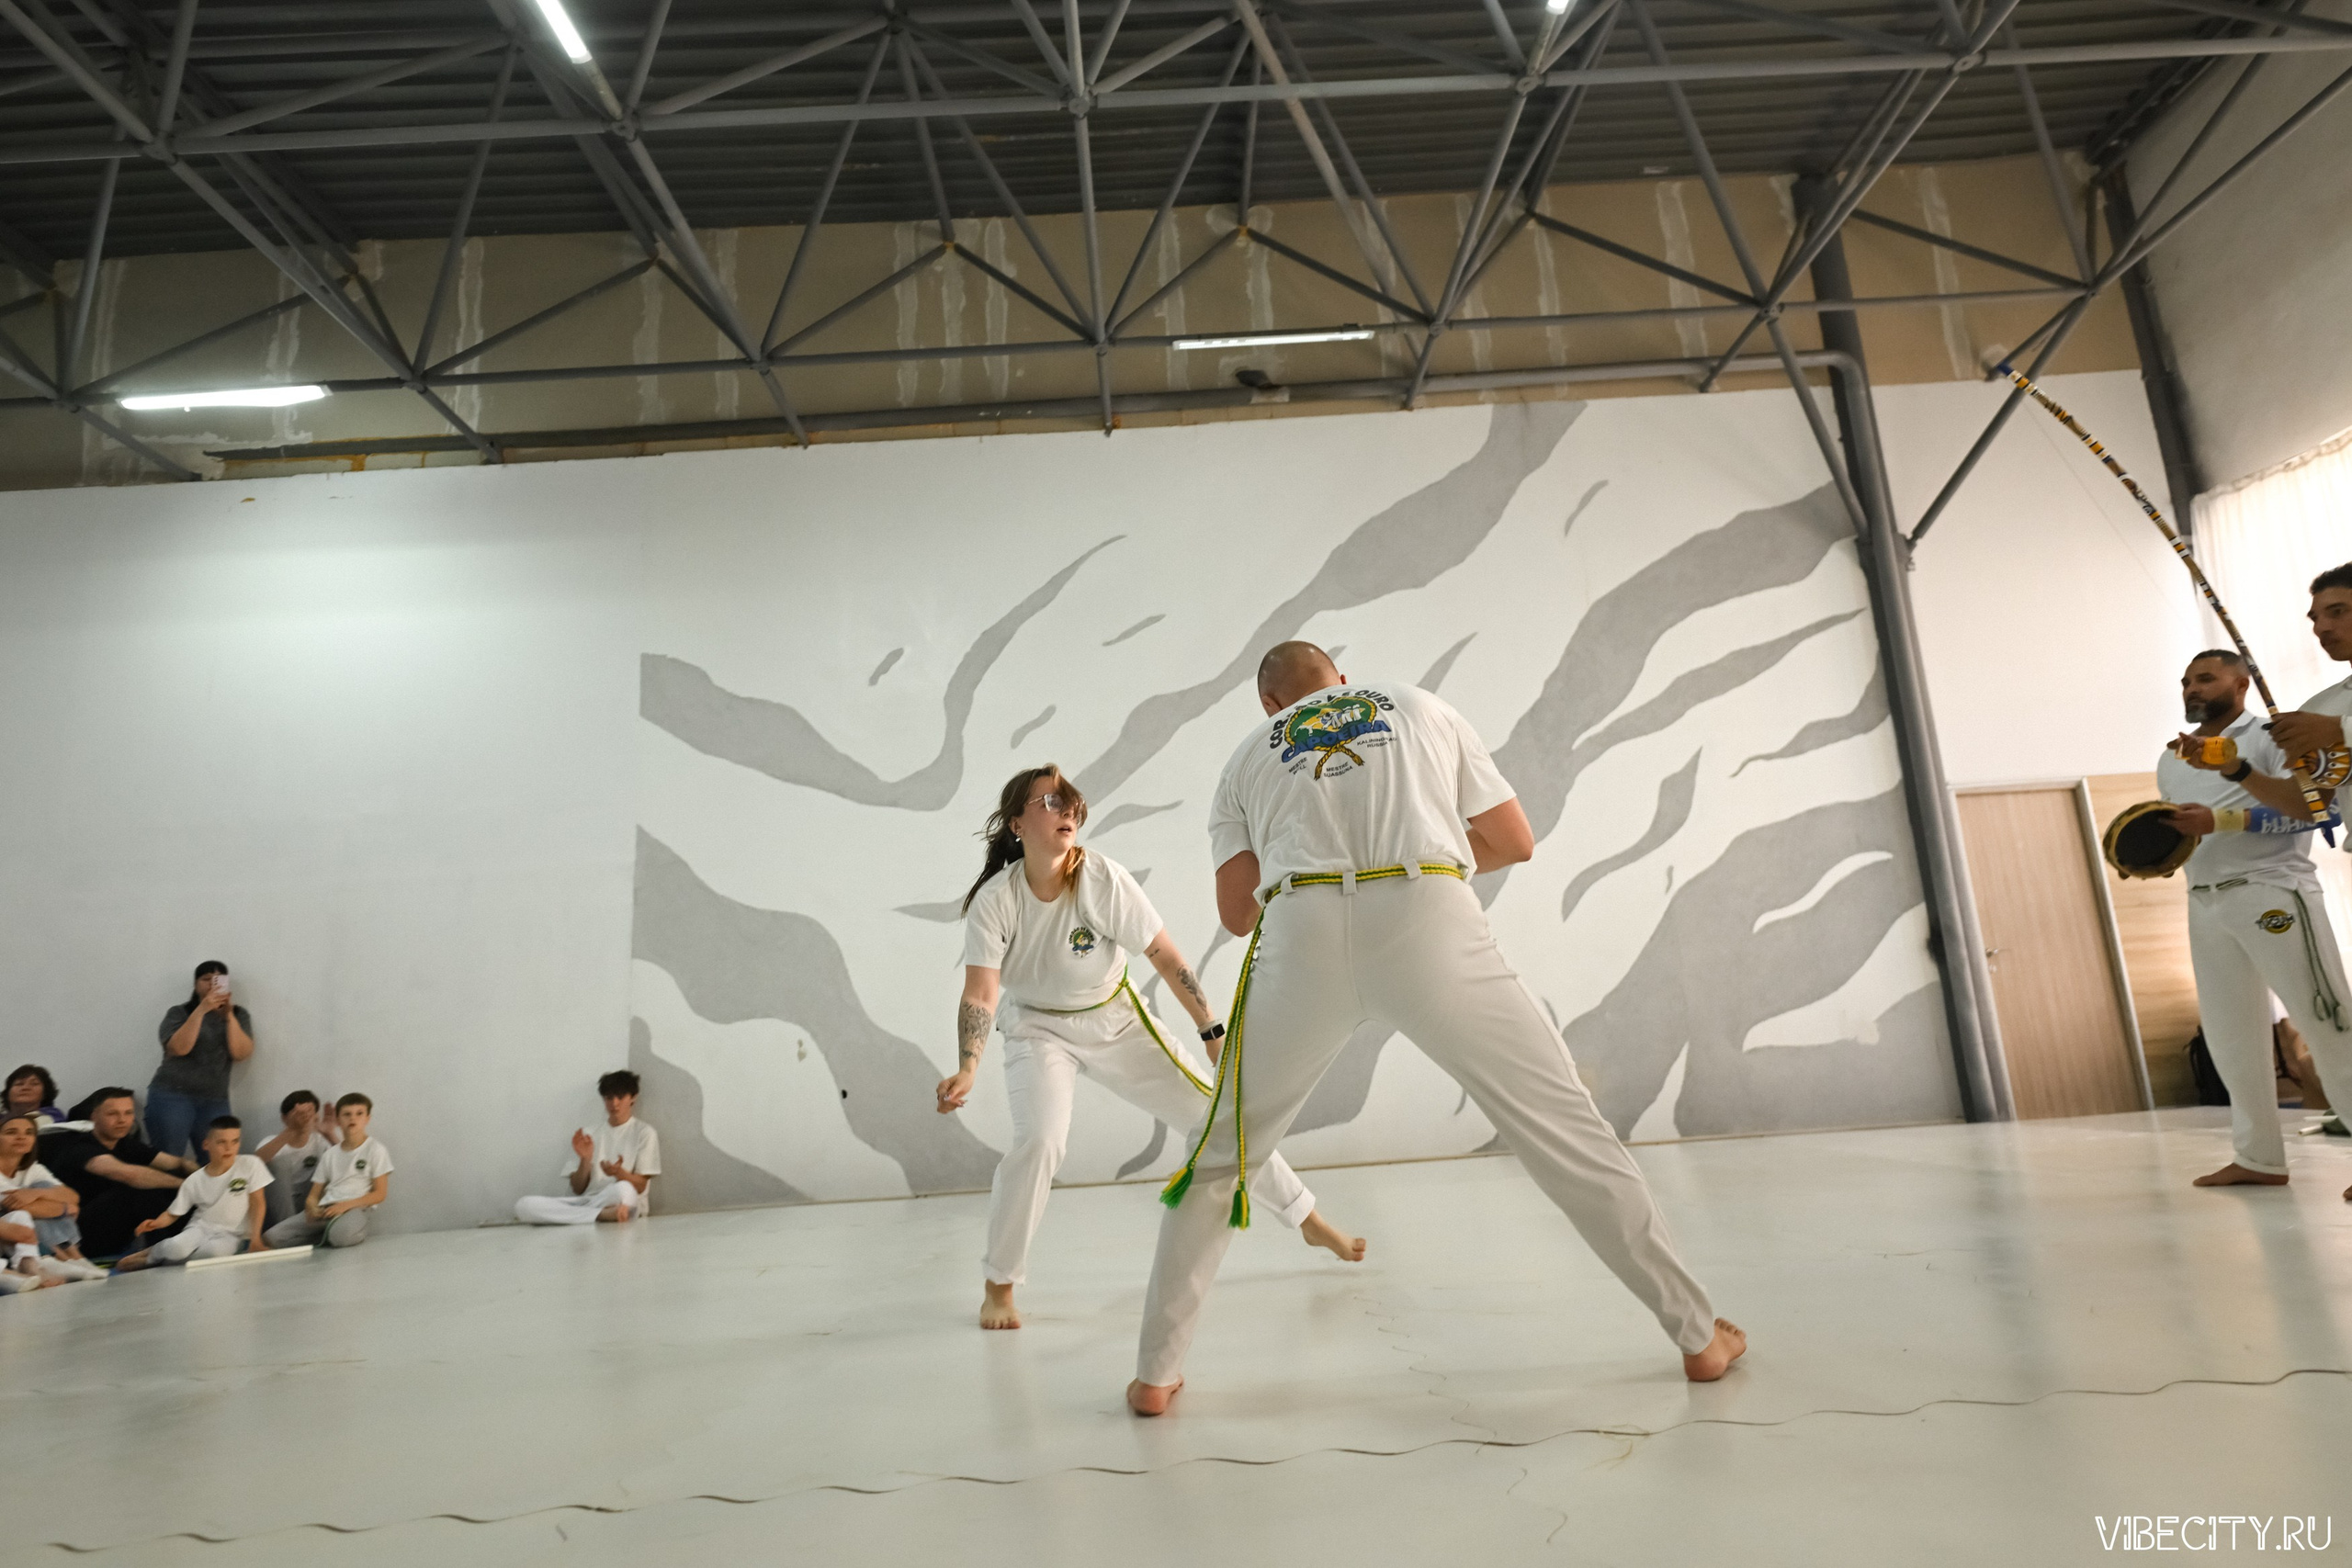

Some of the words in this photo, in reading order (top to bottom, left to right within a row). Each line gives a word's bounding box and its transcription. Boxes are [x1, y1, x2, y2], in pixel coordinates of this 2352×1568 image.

[1270, 700, 1321, 749] CORO
[1355, 690, 1395, 711] OURO
[1282, 720, 1392, 763] CAPOEIRA
[1326, 761, 1349, 772] MESTRE
